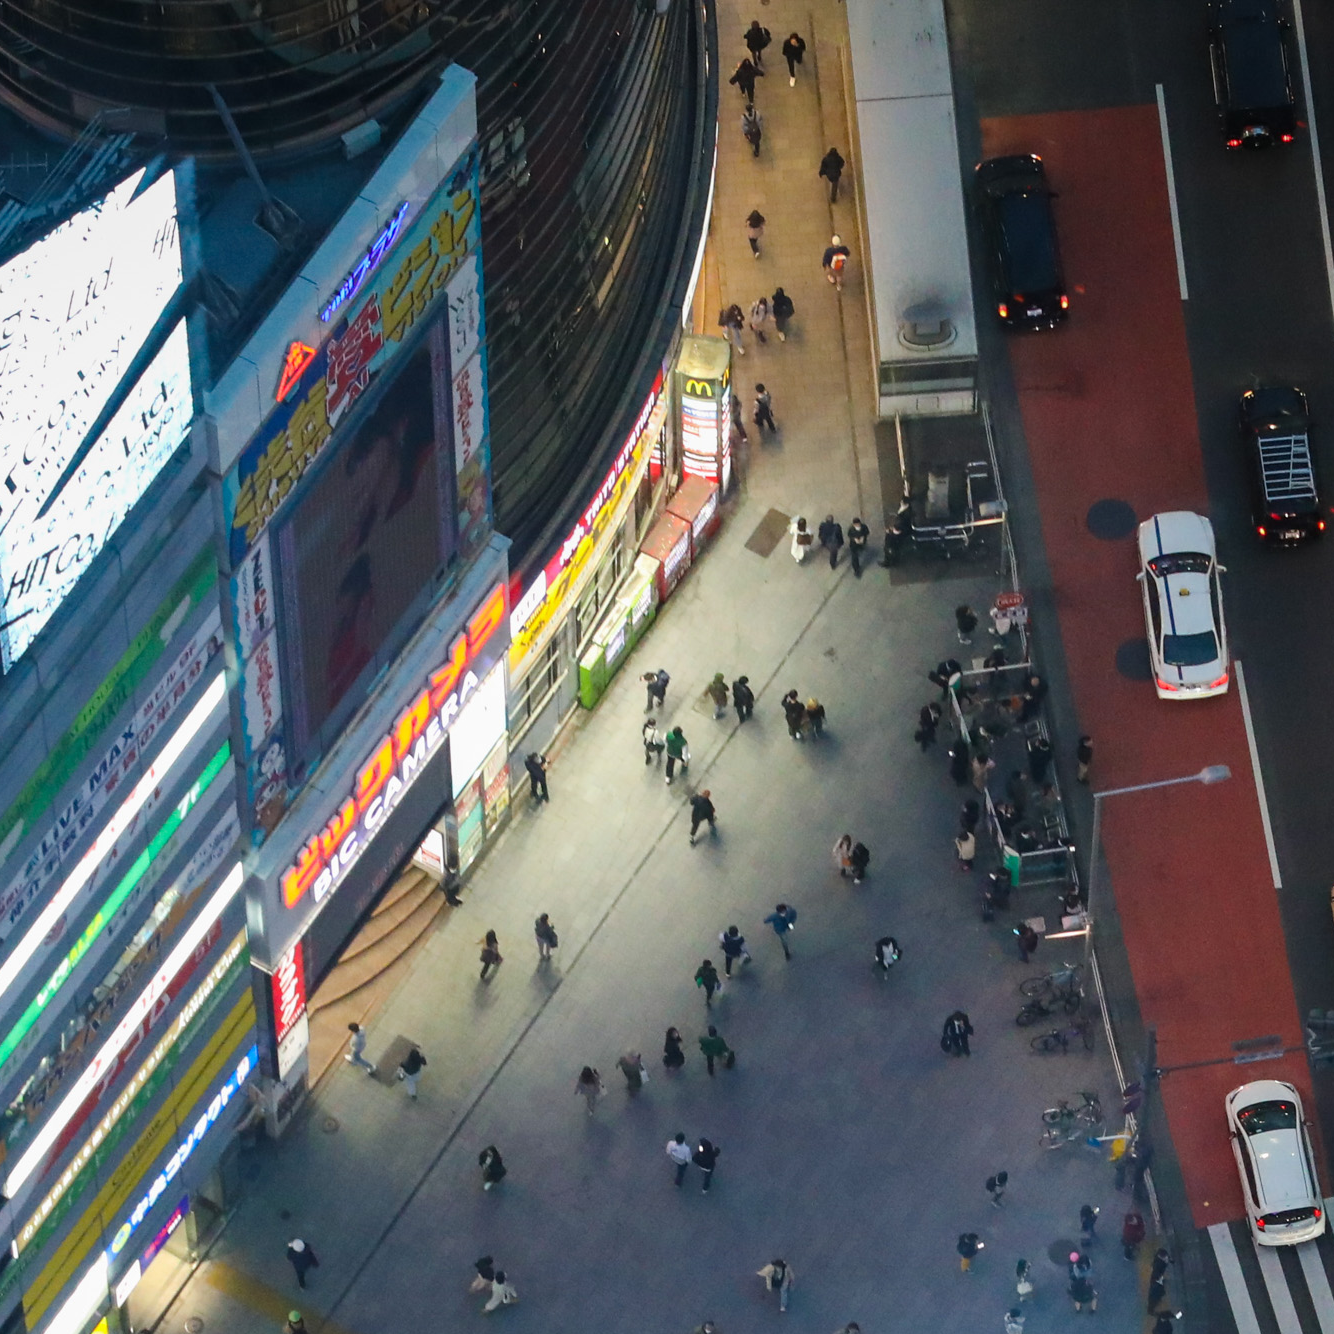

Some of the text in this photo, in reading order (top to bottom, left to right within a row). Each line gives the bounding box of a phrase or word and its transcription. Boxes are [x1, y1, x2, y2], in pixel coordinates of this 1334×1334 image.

[89, 718, 135, 794] MAX
[279, 581, 508, 911] ビックカメラ
[313, 669, 478, 904] BIC CAMERA
[130, 1076, 234, 1230] 中央コンタクト
